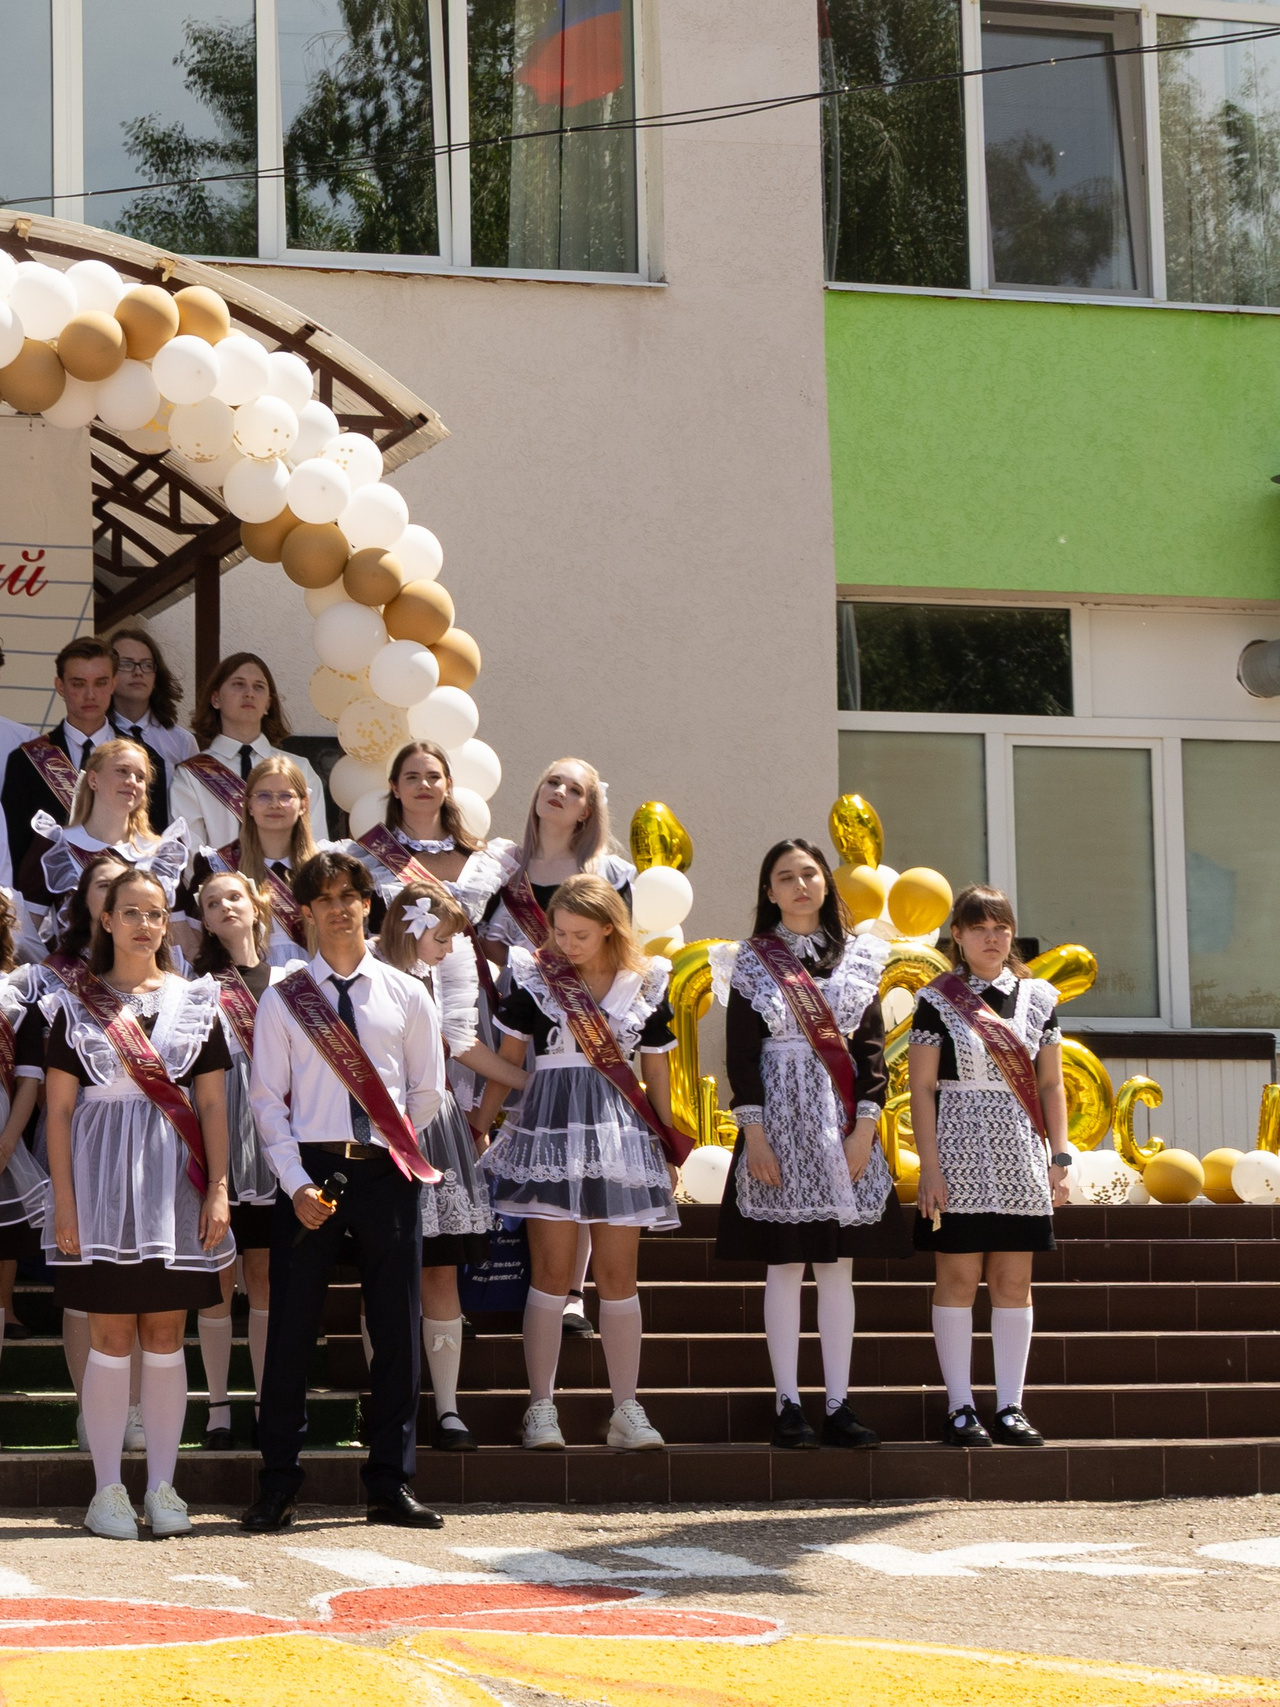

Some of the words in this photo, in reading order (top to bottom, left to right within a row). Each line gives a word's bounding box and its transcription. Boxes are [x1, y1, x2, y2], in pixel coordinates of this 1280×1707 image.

[295, 992, 348, 1055] Выпускник
[342, 1055, 372, 1083] 2026
[810, 1013, 837, 1039] 2026
